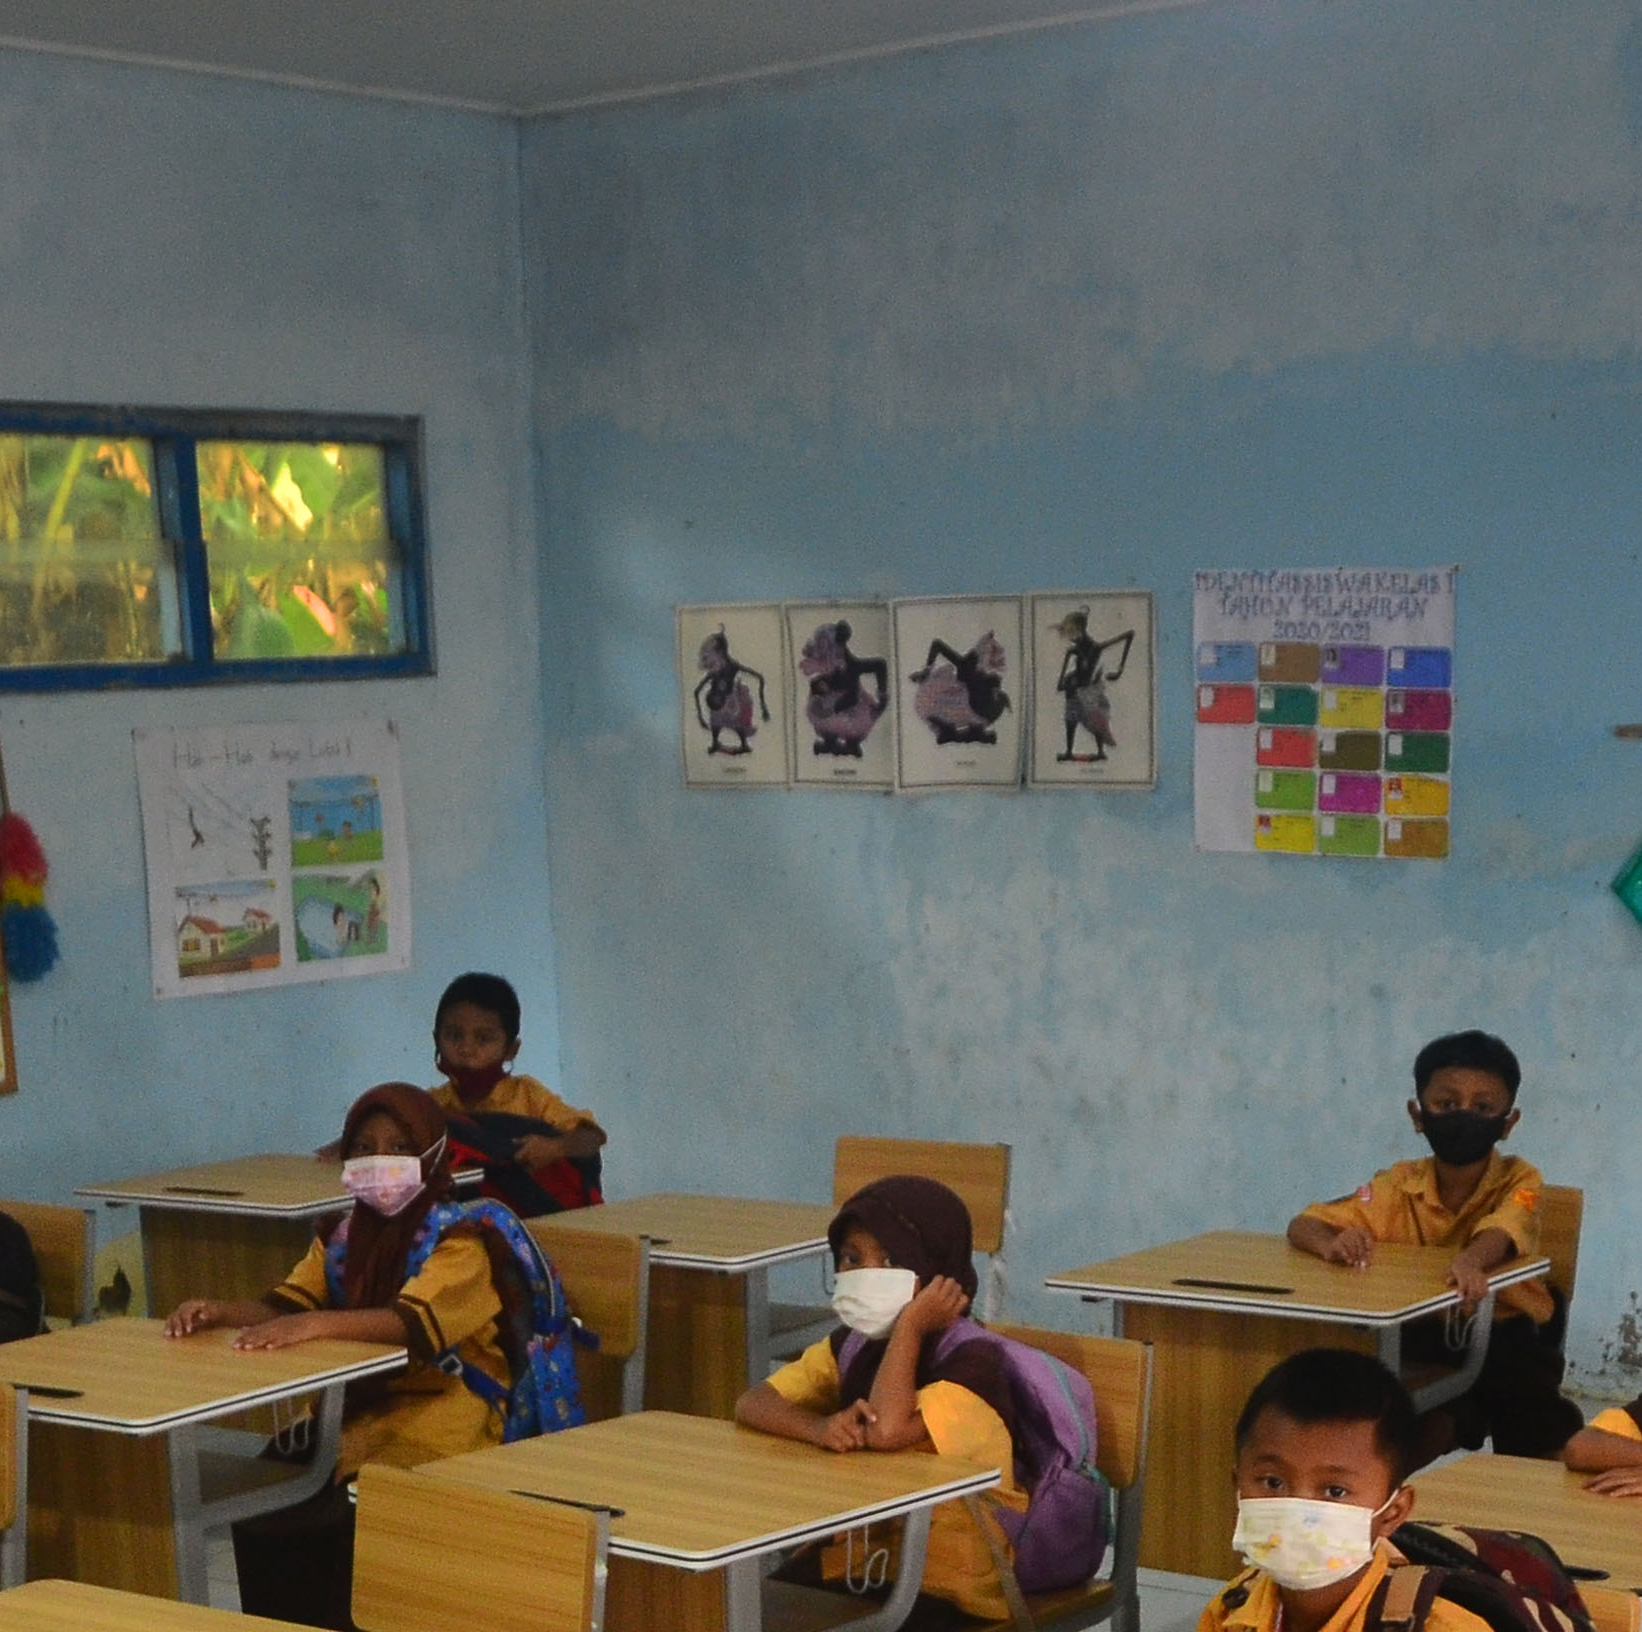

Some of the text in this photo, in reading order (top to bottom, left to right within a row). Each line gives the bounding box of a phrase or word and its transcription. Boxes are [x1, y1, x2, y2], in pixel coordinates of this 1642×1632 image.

[1374, 571, 1441, 594] KELAS
[1302, 595, 1430, 620] PELAJARAN
[1272, 620, 1371, 641] 2020/2021
